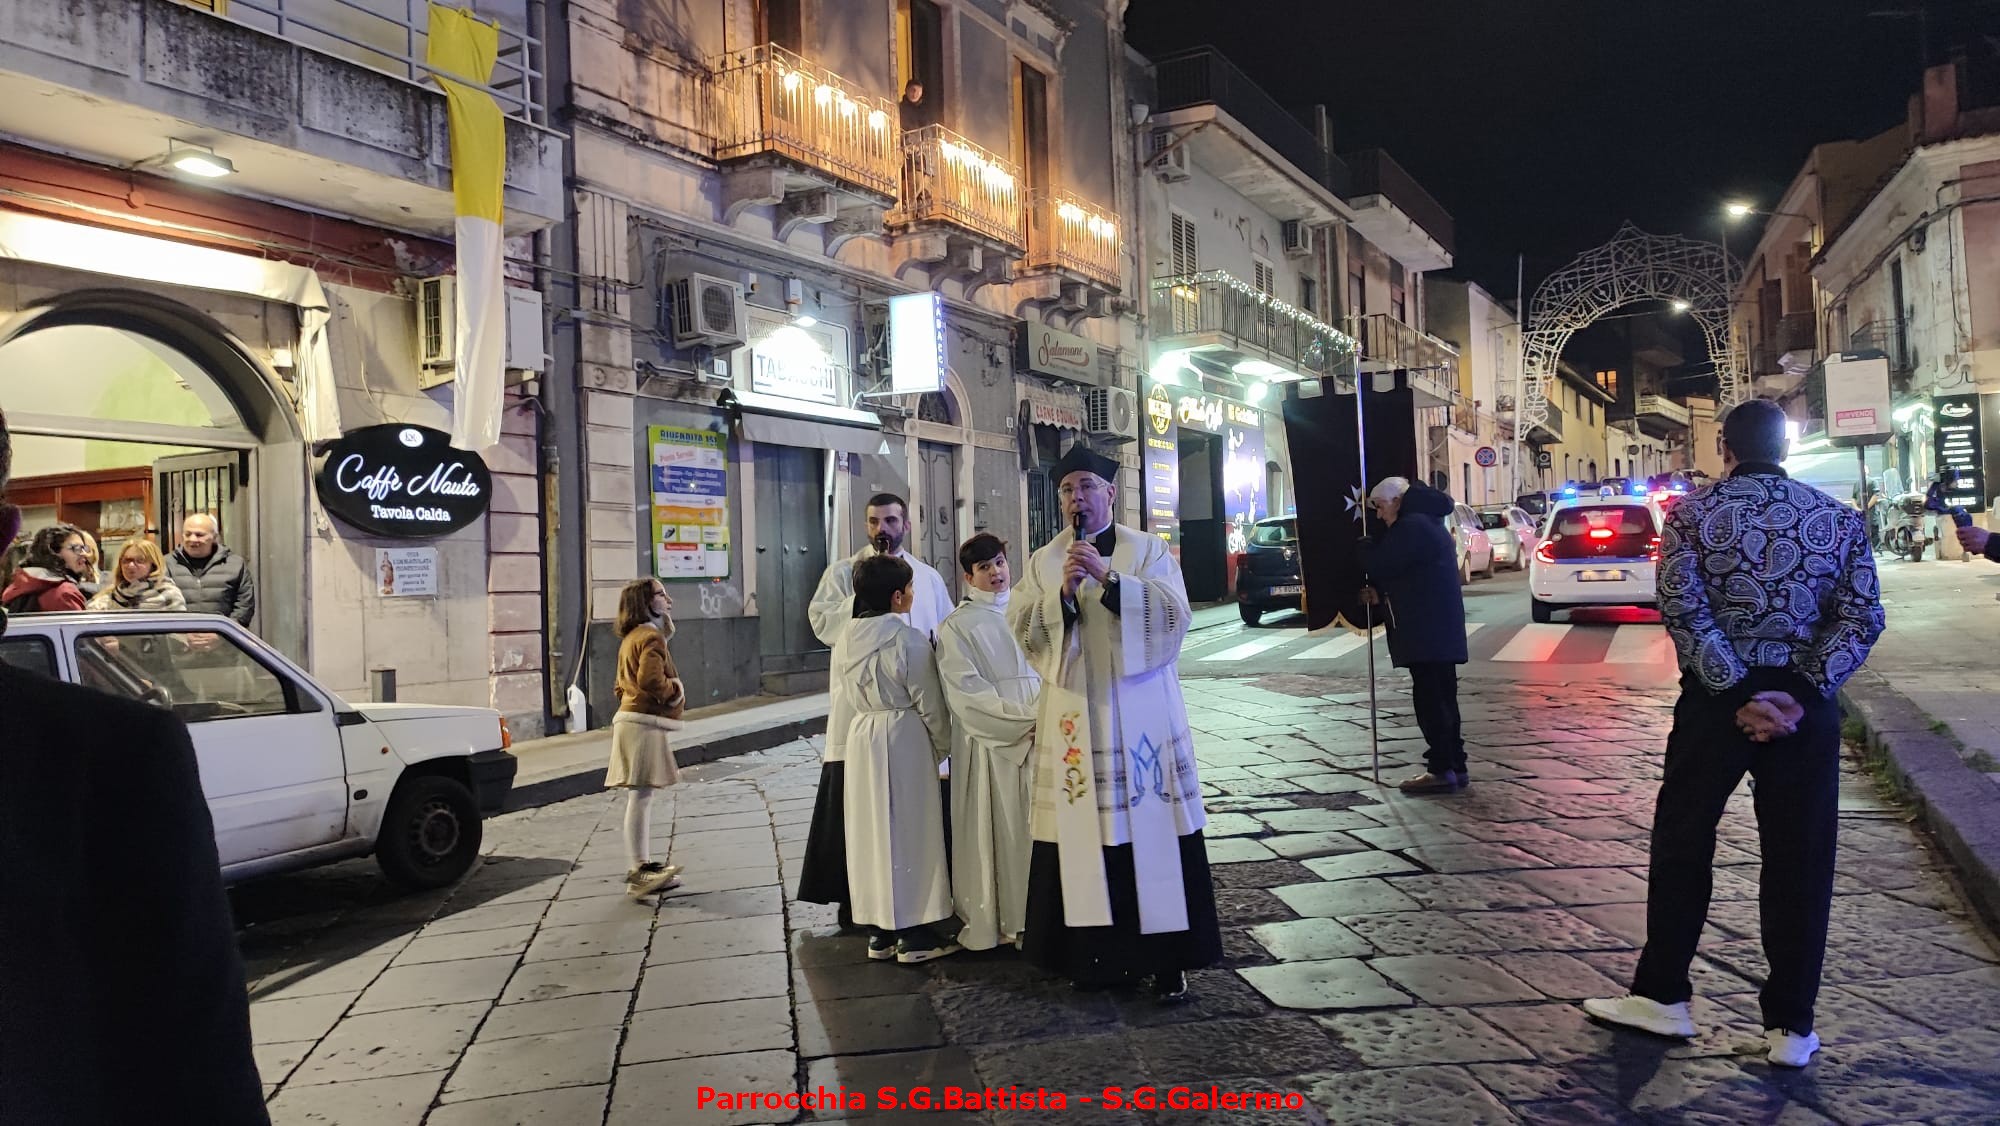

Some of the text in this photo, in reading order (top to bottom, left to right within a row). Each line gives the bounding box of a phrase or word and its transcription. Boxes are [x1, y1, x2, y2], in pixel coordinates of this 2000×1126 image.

[935, 296, 945, 387] TABACCHI
[1038, 332, 1083, 367] Salamone
[1035, 404, 1055, 421] CARNE
[661, 430, 703, 442] RIVENDITA
[336, 453, 480, 500] Caffè Nauta
[371, 504, 452, 521] Tavola Calda
